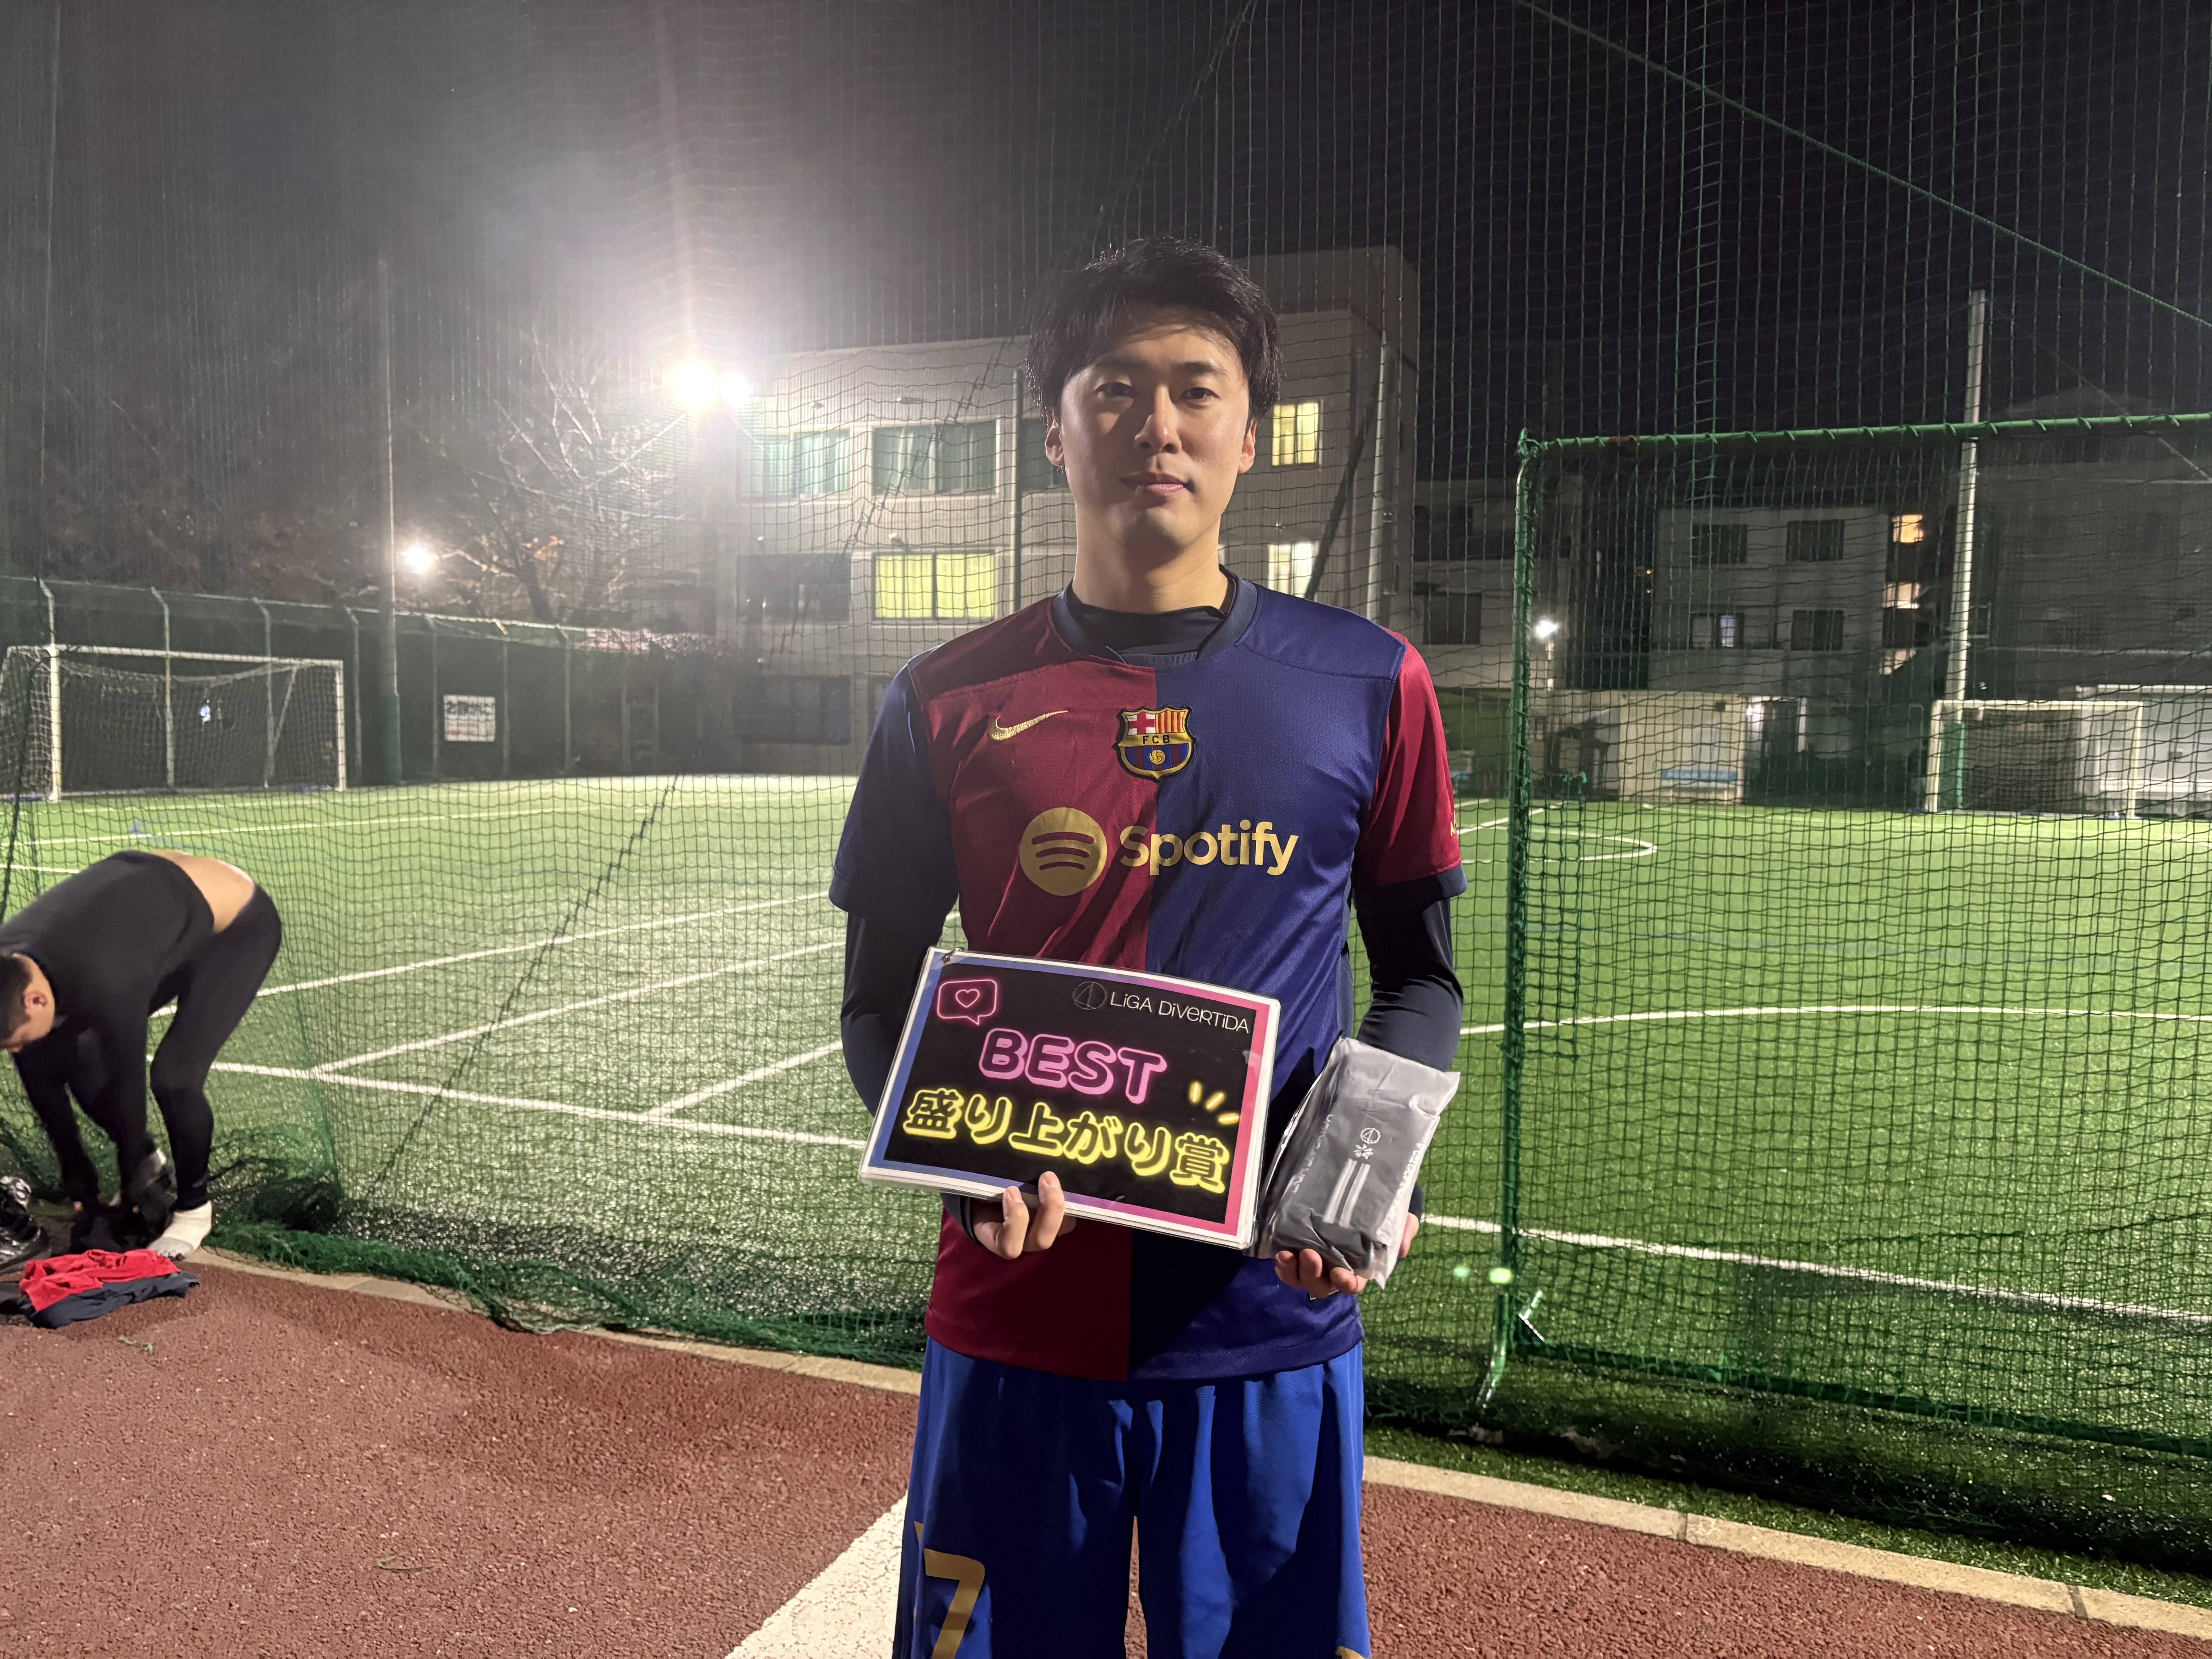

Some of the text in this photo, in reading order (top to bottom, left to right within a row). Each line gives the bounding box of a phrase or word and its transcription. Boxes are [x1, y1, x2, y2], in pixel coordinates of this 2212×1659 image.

[1142, 735, 1170, 745] FCB
[1120, 819, 1299, 876] Spotify
[979, 1027, 1168, 1104] BEST
[903, 1087, 1230, 1194] 盛り上がり賞
[914, 1520, 986, 1659] 7
